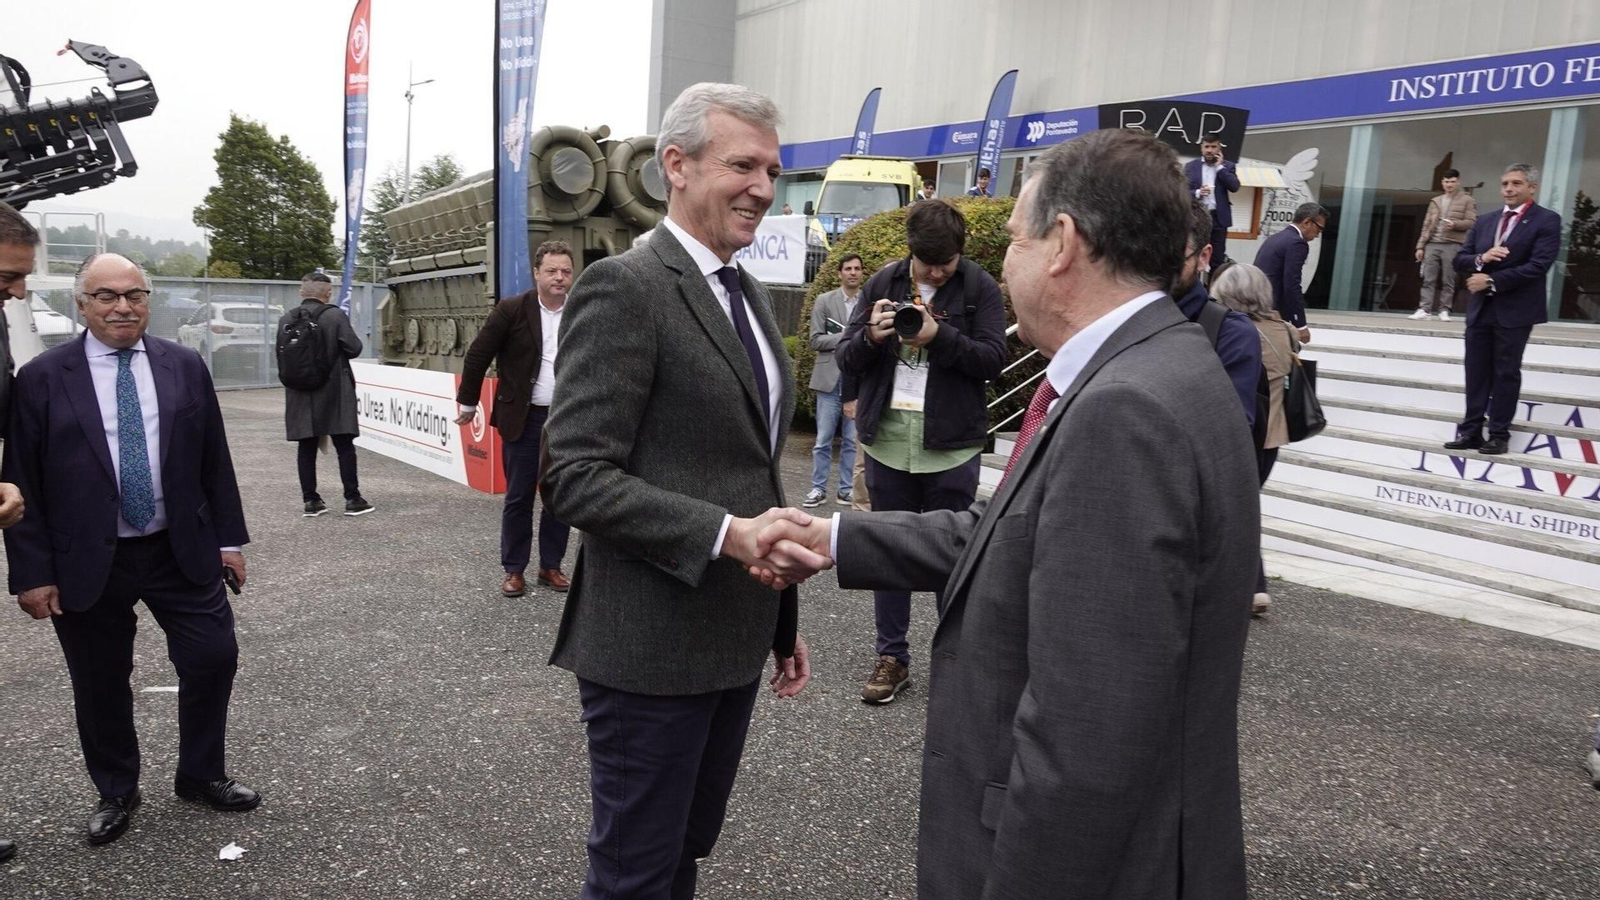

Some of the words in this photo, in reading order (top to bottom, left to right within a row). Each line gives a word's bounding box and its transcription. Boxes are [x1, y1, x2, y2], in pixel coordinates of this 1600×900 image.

[500, 37, 512, 49] No
[500, 58, 512, 70] No
[1388, 61, 1555, 102] INSTITUTO
[1264, 210, 1293, 222] FOOD
[735, 234, 788, 260] ANCA
[364, 392, 387, 422] Urea.
[389, 397, 403, 426] No
[405, 400, 451, 446] Kidding.
[1375, 485, 1527, 526] INTERNATIONAL
